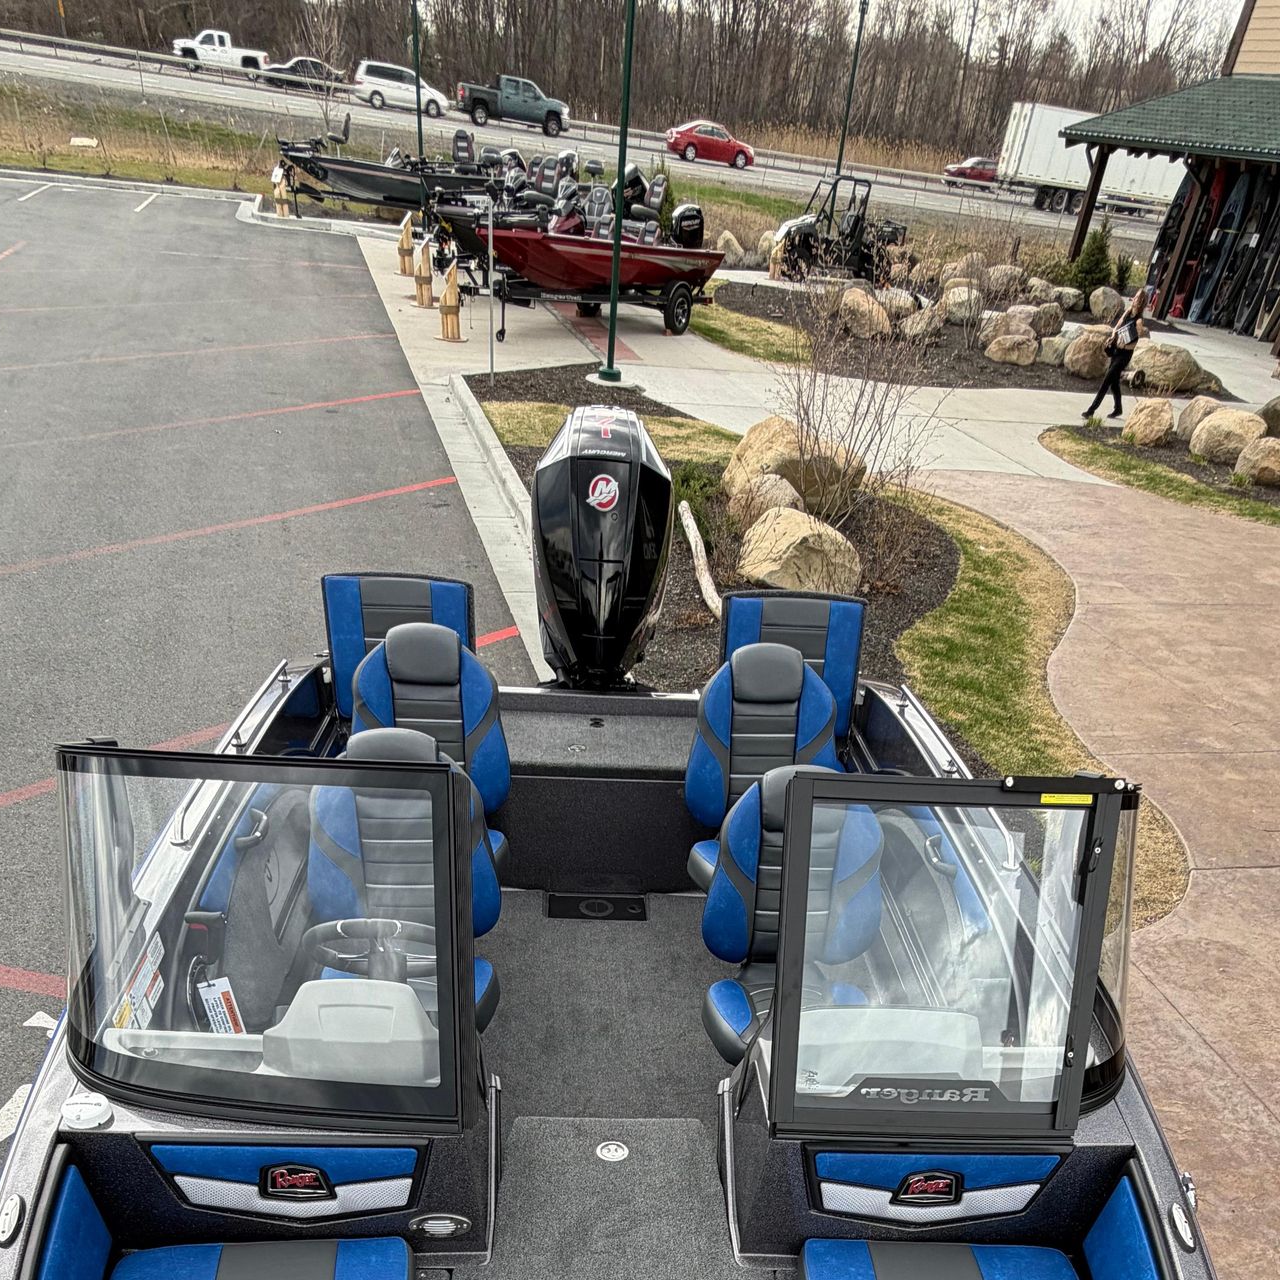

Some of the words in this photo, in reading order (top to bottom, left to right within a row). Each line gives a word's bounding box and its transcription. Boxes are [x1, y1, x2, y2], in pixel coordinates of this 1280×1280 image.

[582, 448, 626, 457] MERCURY
[273, 1170, 317, 1188] Ranger
[908, 1177, 952, 1194] Ranger
